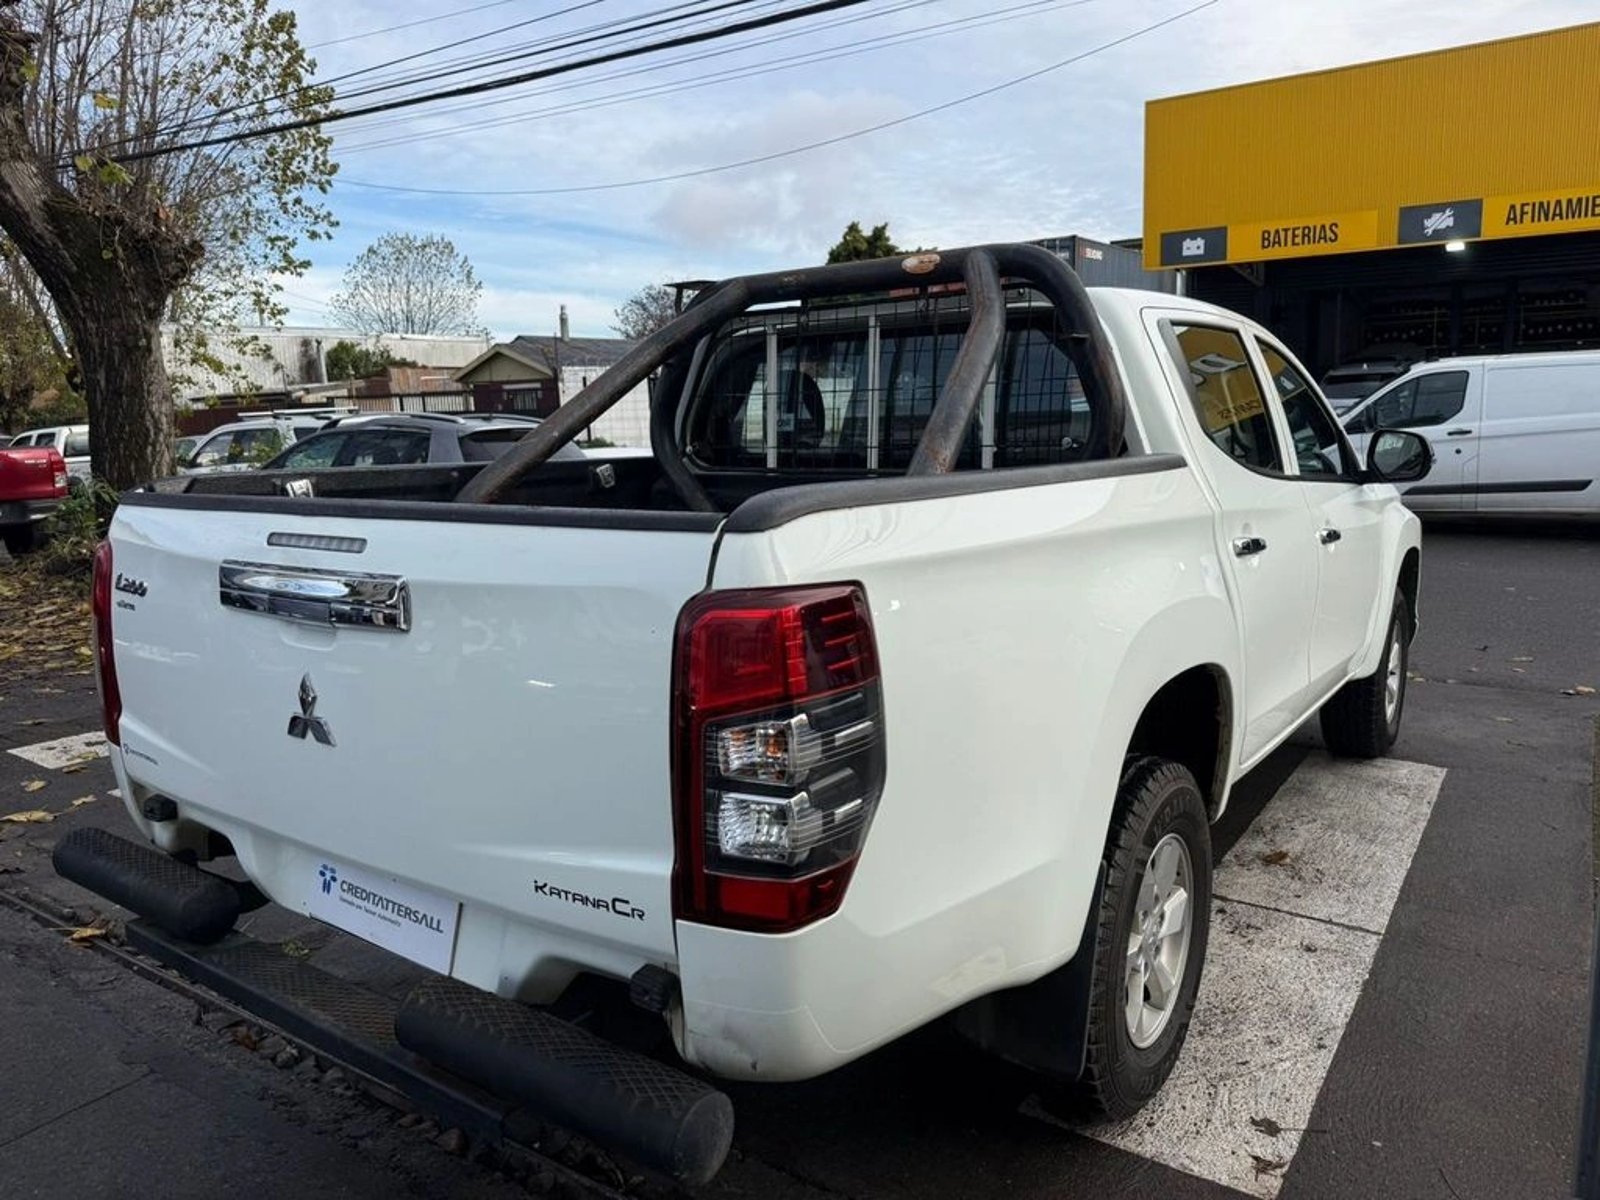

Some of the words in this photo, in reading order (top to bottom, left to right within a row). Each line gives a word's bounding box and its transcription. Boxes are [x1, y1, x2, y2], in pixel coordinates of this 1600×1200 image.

[1505, 195, 1600, 226] AFINAMIE
[1261, 222, 1339, 250] BATERIAS
[340, 880, 444, 934] CREDITATTERSALL
